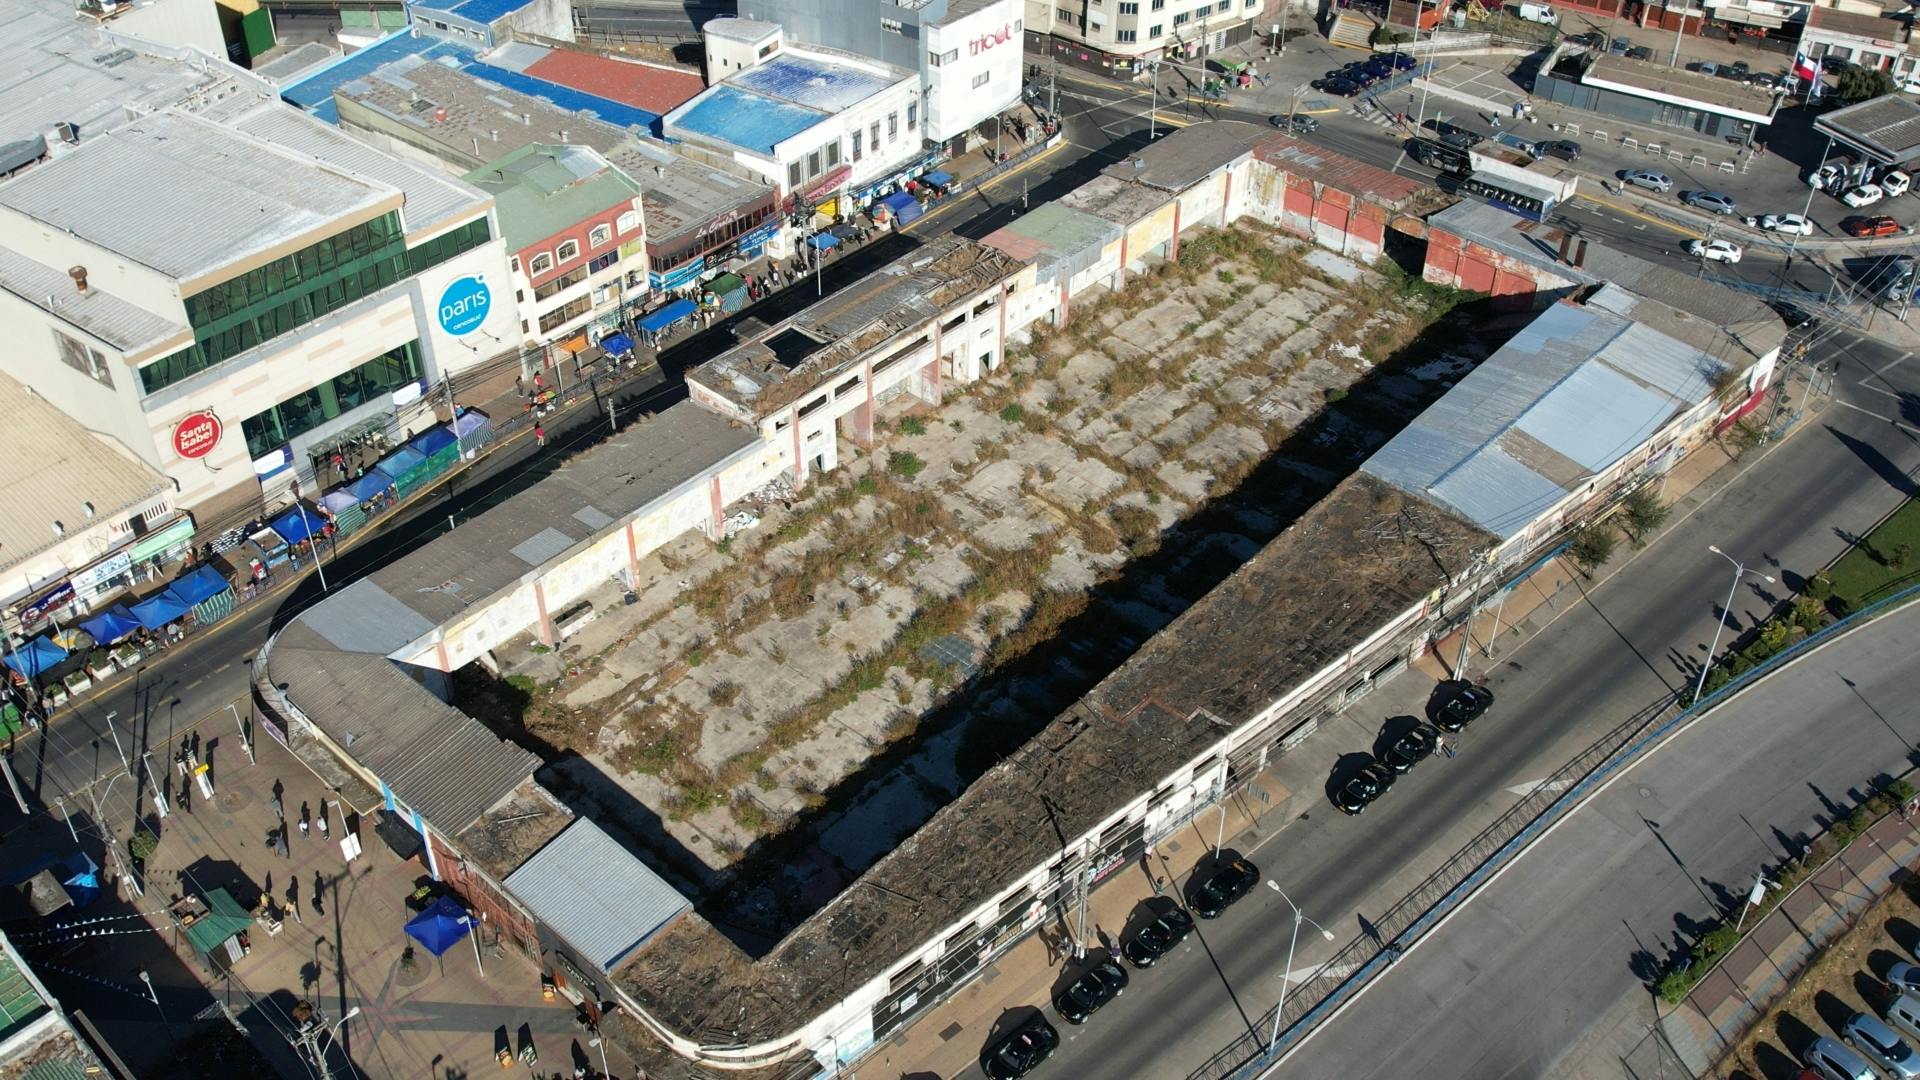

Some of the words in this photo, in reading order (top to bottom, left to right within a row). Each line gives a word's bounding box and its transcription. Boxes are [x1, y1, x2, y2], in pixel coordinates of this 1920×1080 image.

[969, 23, 1011, 56] tricot
[441, 290, 487, 326] paris
[180, 421, 213, 441] Santa
